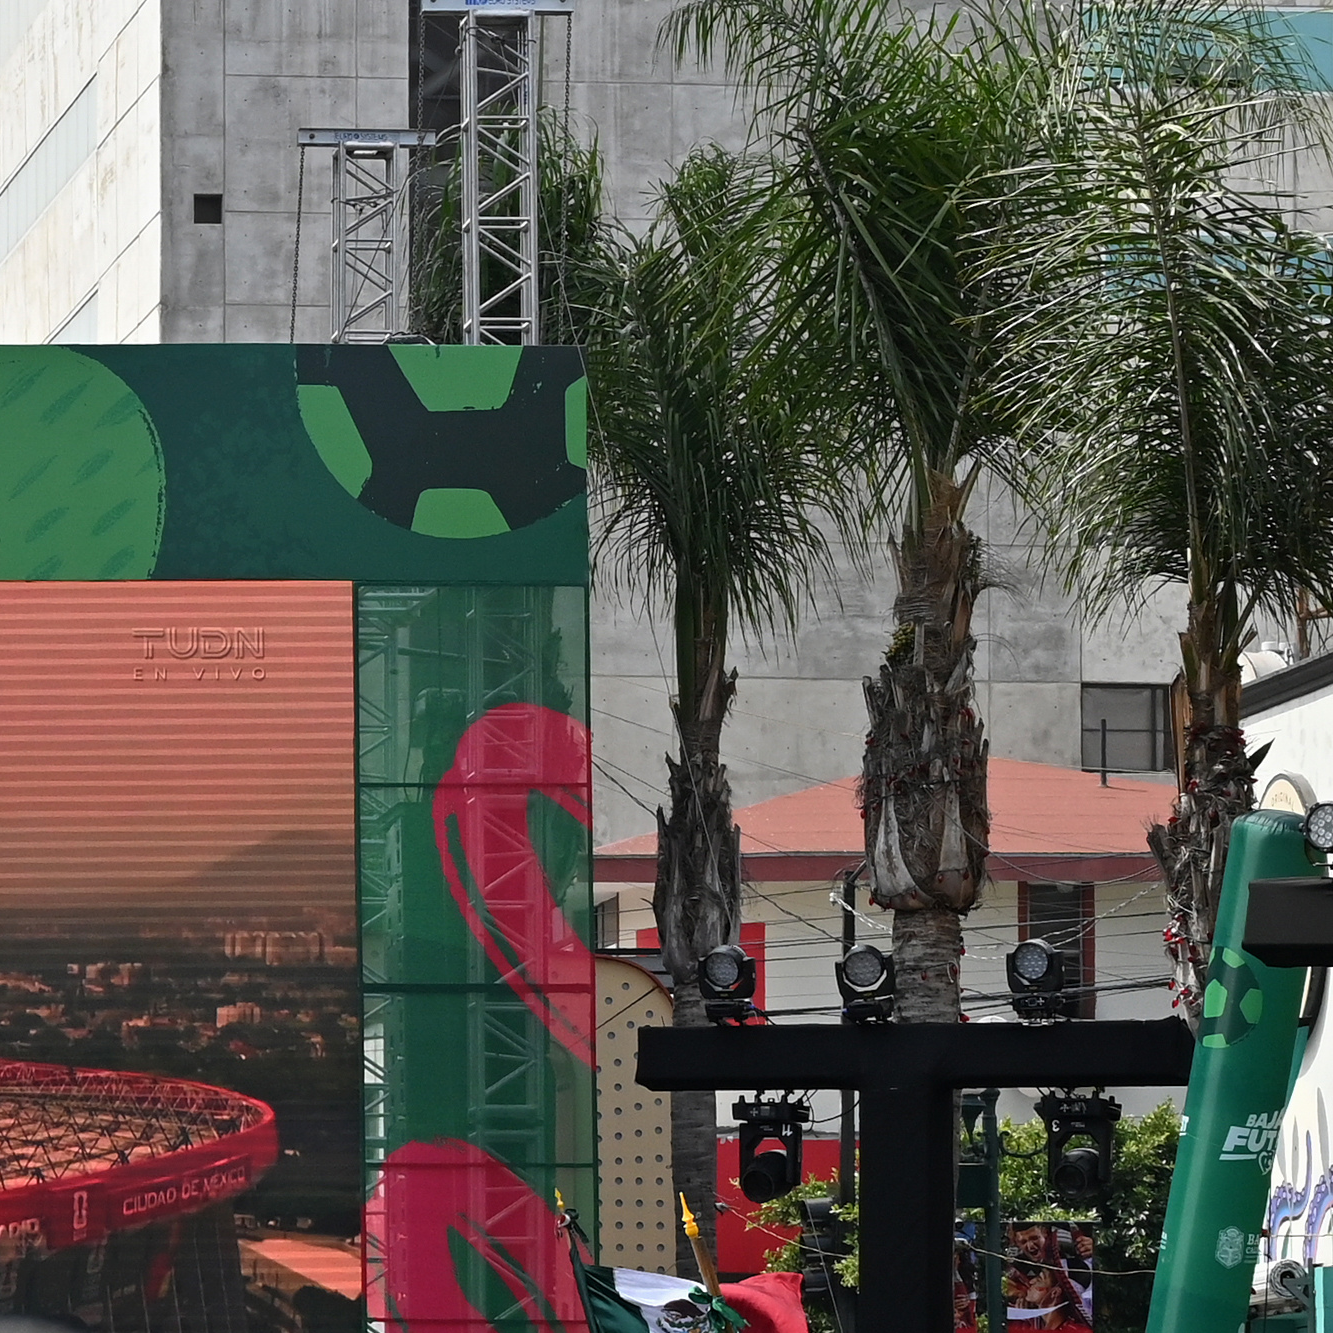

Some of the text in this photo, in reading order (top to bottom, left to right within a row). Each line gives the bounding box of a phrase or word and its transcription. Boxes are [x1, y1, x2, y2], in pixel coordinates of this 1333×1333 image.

[132, 627, 265, 660] TUDN
[133, 667, 267, 681] EN VIVO
